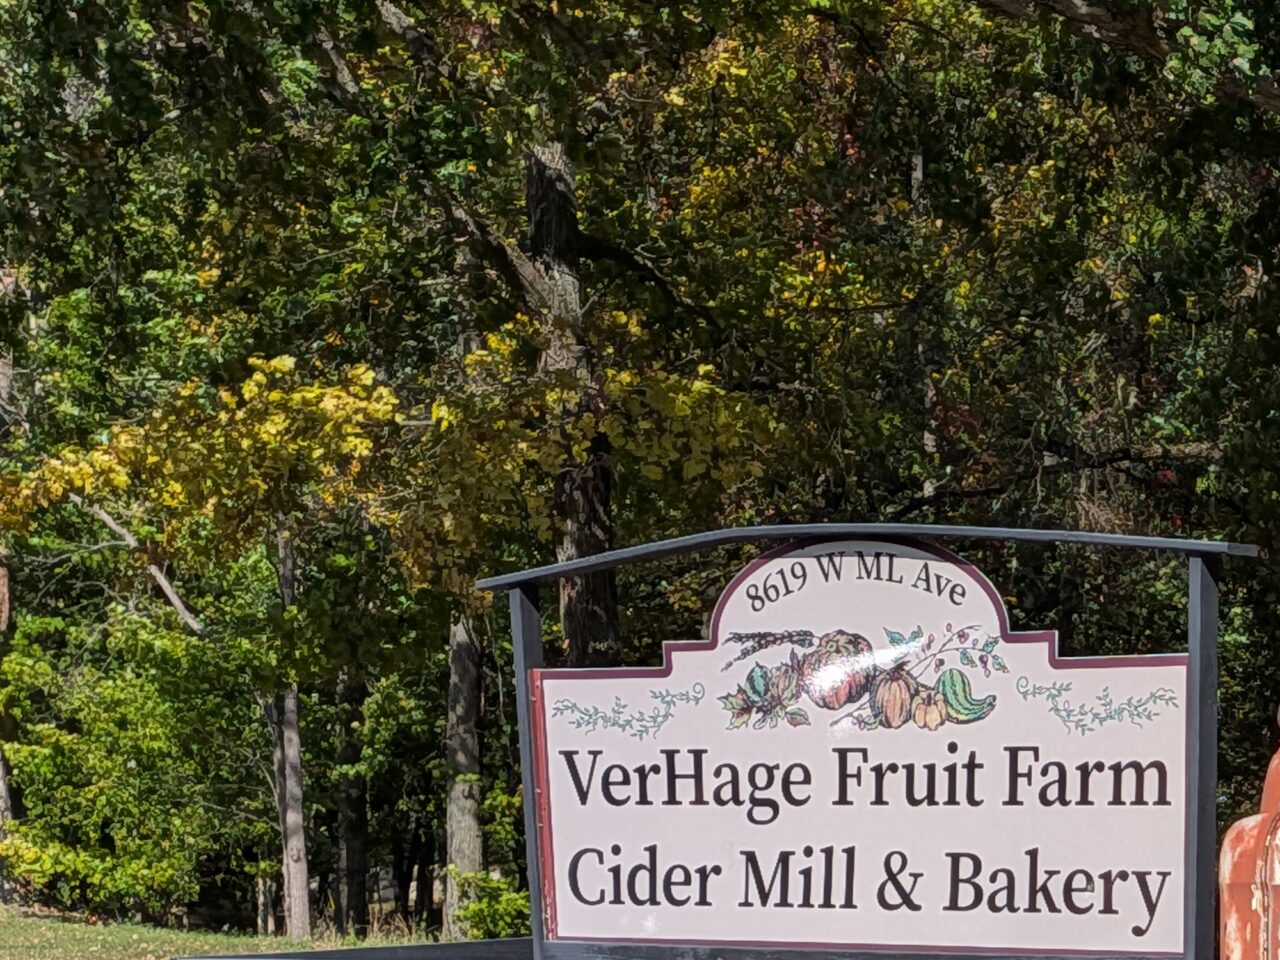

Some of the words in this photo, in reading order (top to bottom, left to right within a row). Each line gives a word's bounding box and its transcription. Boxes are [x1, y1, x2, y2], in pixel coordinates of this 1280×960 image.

[745, 561, 808, 612] 8619
[815, 551, 846, 582] W
[854, 550, 903, 584] ML
[911, 561, 967, 606] Ave
[558, 748, 812, 825] VerHage
[832, 741, 984, 807] Fruit
[1002, 746, 1172, 807] Farm
[568, 844, 722, 907] Cider
[738, 845, 858, 910] Mill
[876, 850, 924, 912] &
[943, 847, 1172, 937] Bakery
